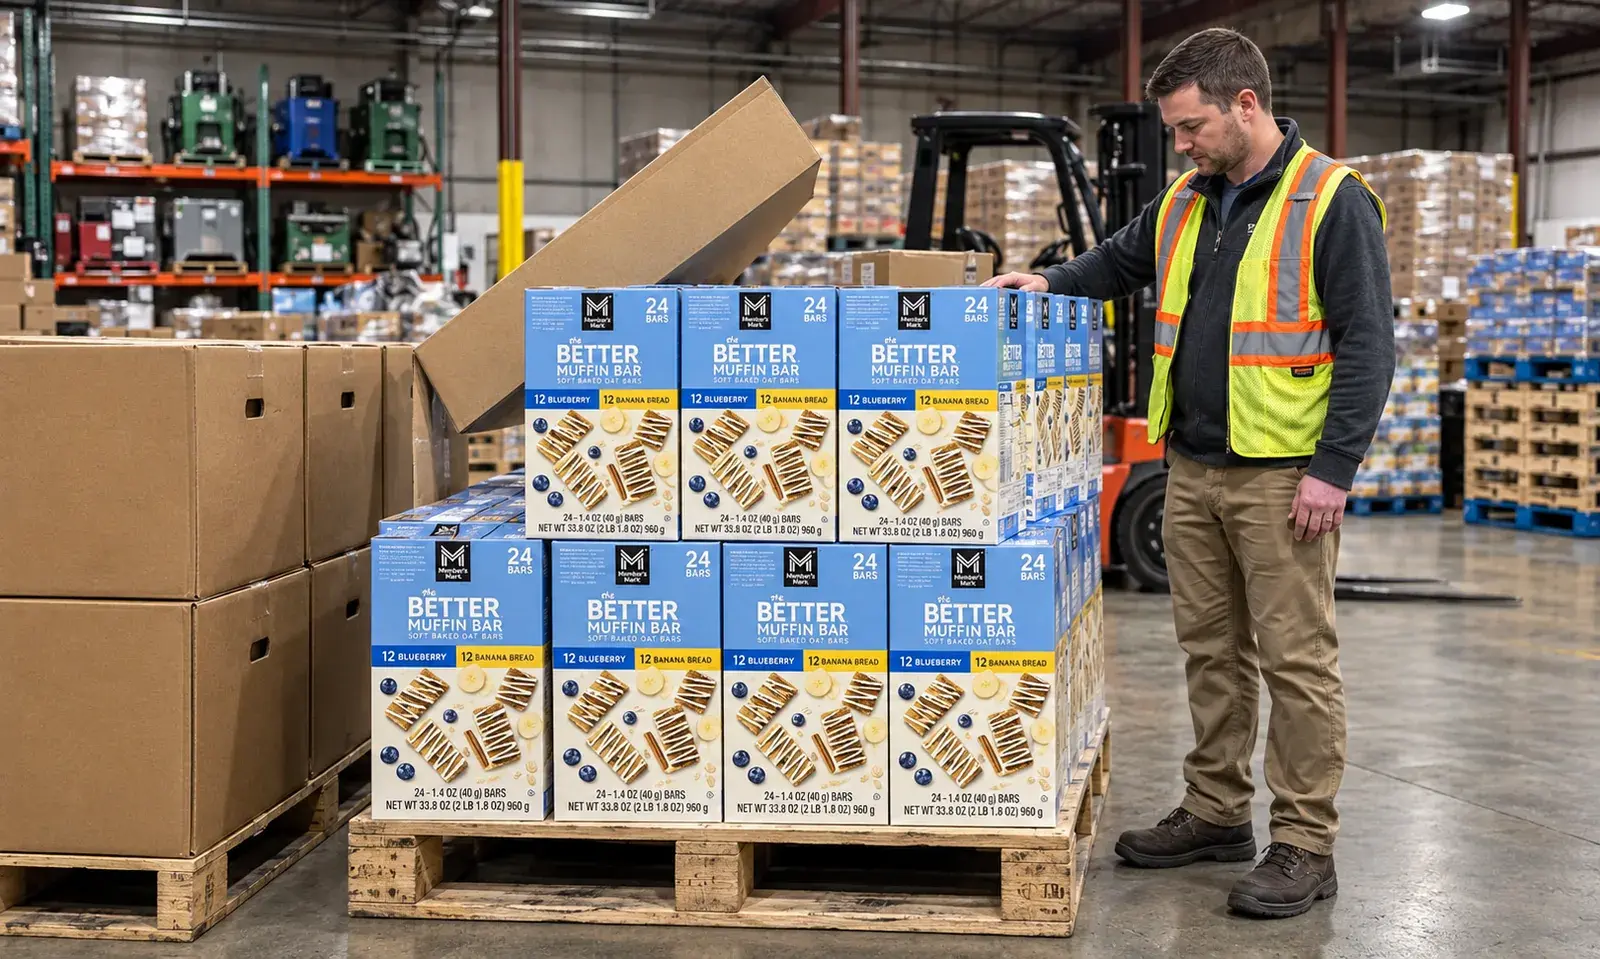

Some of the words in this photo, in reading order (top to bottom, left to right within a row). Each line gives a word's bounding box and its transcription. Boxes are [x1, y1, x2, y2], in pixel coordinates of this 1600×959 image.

[646, 297, 669, 314] 24
[804, 296, 827, 313] 24
[965, 296, 988, 313] 24
[646, 314, 669, 323] BARS
[804, 314, 827, 322] BARS
[964, 314, 988, 322] BARS
[557, 344, 638, 364] BETTER
[714, 344, 796, 363] BETTER
[872, 344, 956, 364] BETTER
[557, 365, 609, 376] MUFFIN
[614, 365, 641, 376] BAR
[713, 364, 766, 376] MUFFIN
[772, 364, 799, 376] BAR
[872, 364, 925, 376] MUFFIN
[931, 365, 959, 377] BAR
[534, 394, 546, 404] 12
[548, 396, 590, 404] BLUEBERRY
[604, 395, 614, 404] 12
[691, 393, 702, 404] 12
[760, 394, 771, 404] 12
[804, 396, 828, 404] BREAD
[848, 394, 860, 405] 12
[920, 395, 931, 405] 12
[941, 517, 962, 527] BARS
[508, 547, 533, 565] 24
[686, 550, 711, 568] 24
[853, 553, 877, 570] 24
[1021, 553, 1046, 571] 24
[508, 566, 533, 574] BARS
[686, 569, 711, 577] BARS
[853, 571, 878, 580] BARS
[1021, 572, 1045, 581] BARS
[408, 597, 499, 618] BETTER
[588, 600, 678, 621] BETTER
[757, 601, 845, 622] BETTER
[924, 603, 1013, 624] BETTER
[408, 619, 466, 631] MUFFIN
[472, 619, 502, 632] BAR
[588, 621, 645, 634] MUFFIN
[651, 622, 681, 634] BAR
[757, 623, 813, 636] MUFFIN
[819, 623, 848, 636] BAR
[924, 624, 981, 637] MUFFIN
[987, 625, 1016, 637] BAR
[382, 650, 395, 662] 12
[398, 653, 447, 661] BLUEBERRY
[462, 651, 473, 662] 12
[563, 653, 576, 663] 12
[579, 655, 626, 663] BLUEBERRY
[640, 654, 651, 664] 12
[653, 656, 685, 664] BANANA
[733, 655, 745, 665] 12
[748, 657, 794, 665] BLUEBERRY
[808, 656, 820, 666] 12
[900, 656, 912, 667] 12
[915, 658, 962, 666] BLUEBERRY
[975, 657, 987, 667] 12
[988, 659, 1020, 667] BANANA
[1022, 659, 1047, 667] BREAD
[484, 788, 506, 798] BARS
[664, 790, 686, 800] BARS
[831, 792, 853, 802] BARS
[998, 794, 1020, 804] BARS
[386, 800, 402, 810] NET
[404, 800, 418, 810] WT
[419, 800, 437, 810] 33.8
[463, 801, 474, 810] LB
[476, 801, 489, 810] 1.8
[507, 801, 522, 811] 960
[568, 801, 584, 811] NET
[586, 802, 599, 811] WT
[601, 802, 619, 812] 33.8
[643, 802, 654, 812] LB
[656, 802, 669, 812] 1.8
[686, 803, 701, 812] 960
[737, 804, 753, 813] NET
[754, 804, 767, 813] WT
[769, 804, 786, 813] 33.8
[811, 804, 821, 814] LB
[823, 804, 836, 814] 1.8
[853, 805, 868, 814] 960
[904, 806, 920, 815] NET
[921, 806, 934, 815] WT
[936, 806, 954, 816] 33.8
[978, 806, 988, 816] LB
[991, 806, 1003, 816] 1.8
[1020, 806, 1036, 816] 960
